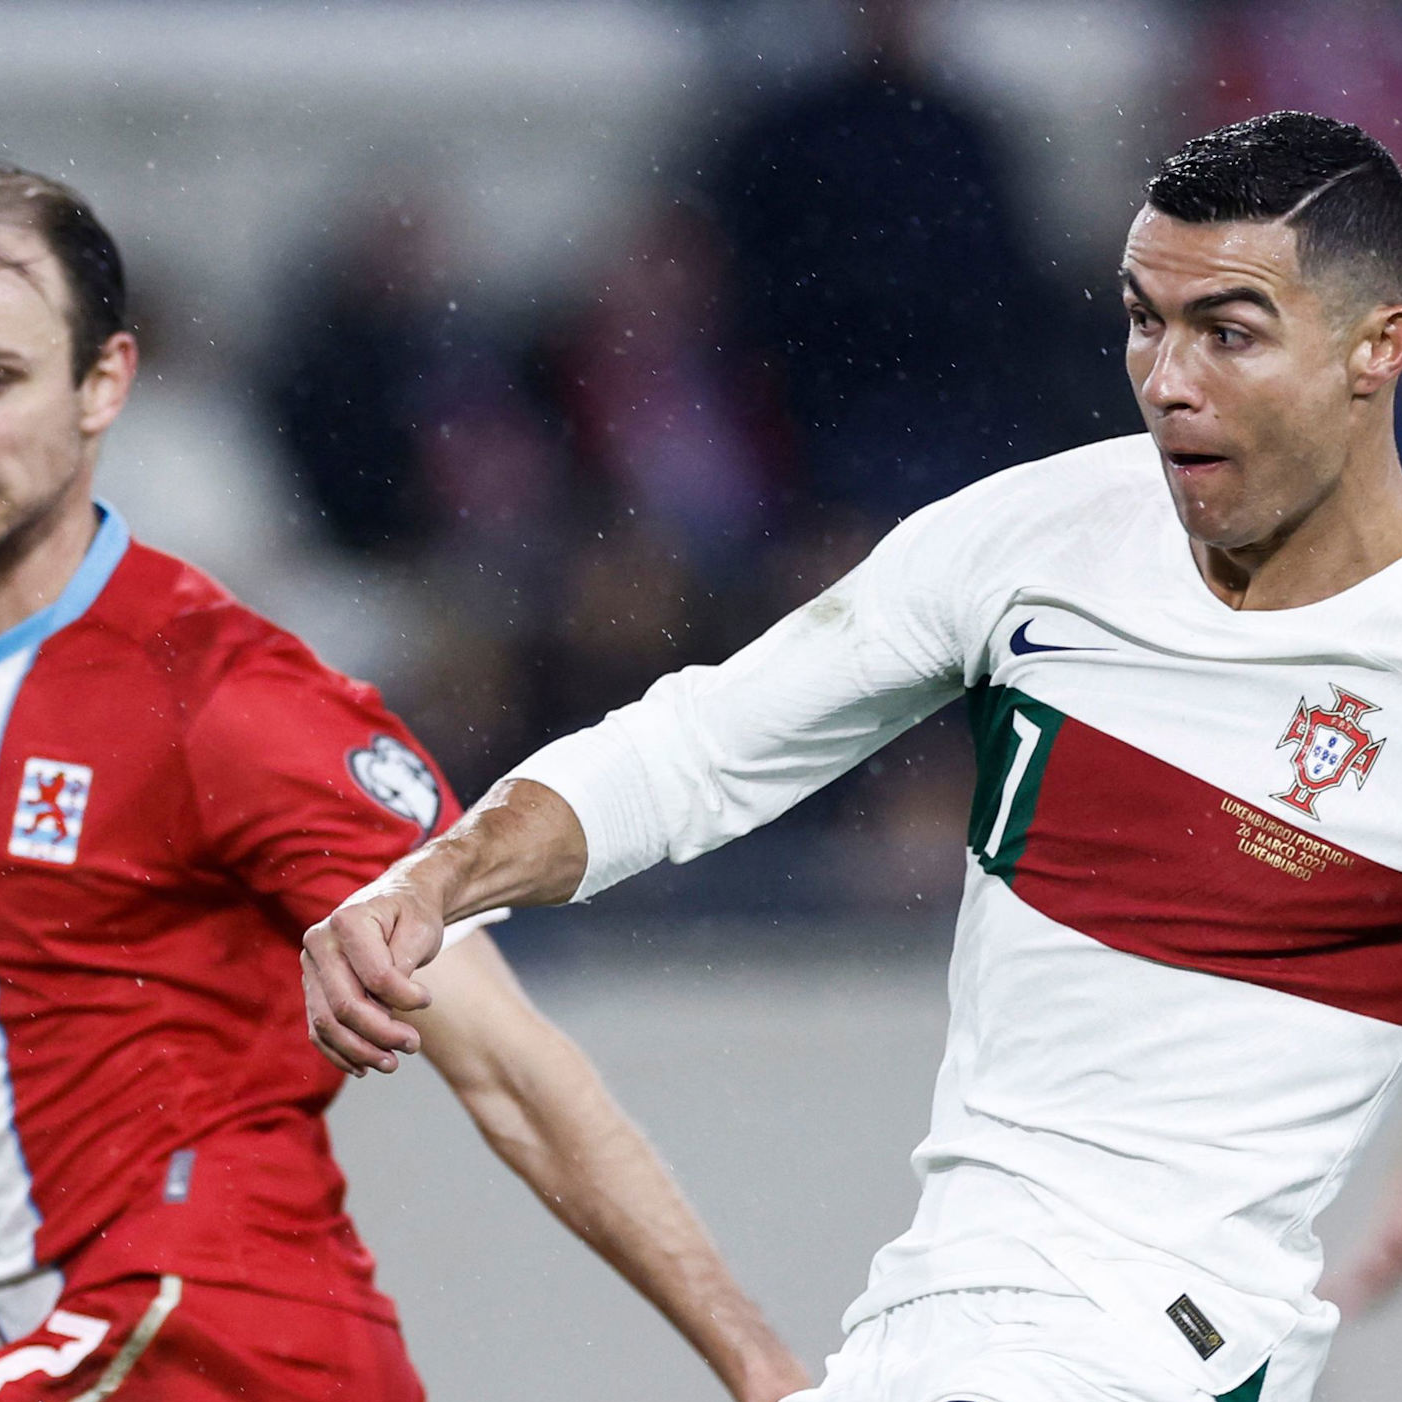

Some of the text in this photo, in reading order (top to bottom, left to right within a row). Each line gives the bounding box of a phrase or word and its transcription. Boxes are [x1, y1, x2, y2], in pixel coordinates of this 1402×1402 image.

[1220, 796, 1356, 870] LUXEMBURGO/PORTUGAL
[1235, 822, 1253, 839] 26
[1296, 850, 1328, 874] 2023
[1237, 837, 1313, 882] LUXEMBURGO
